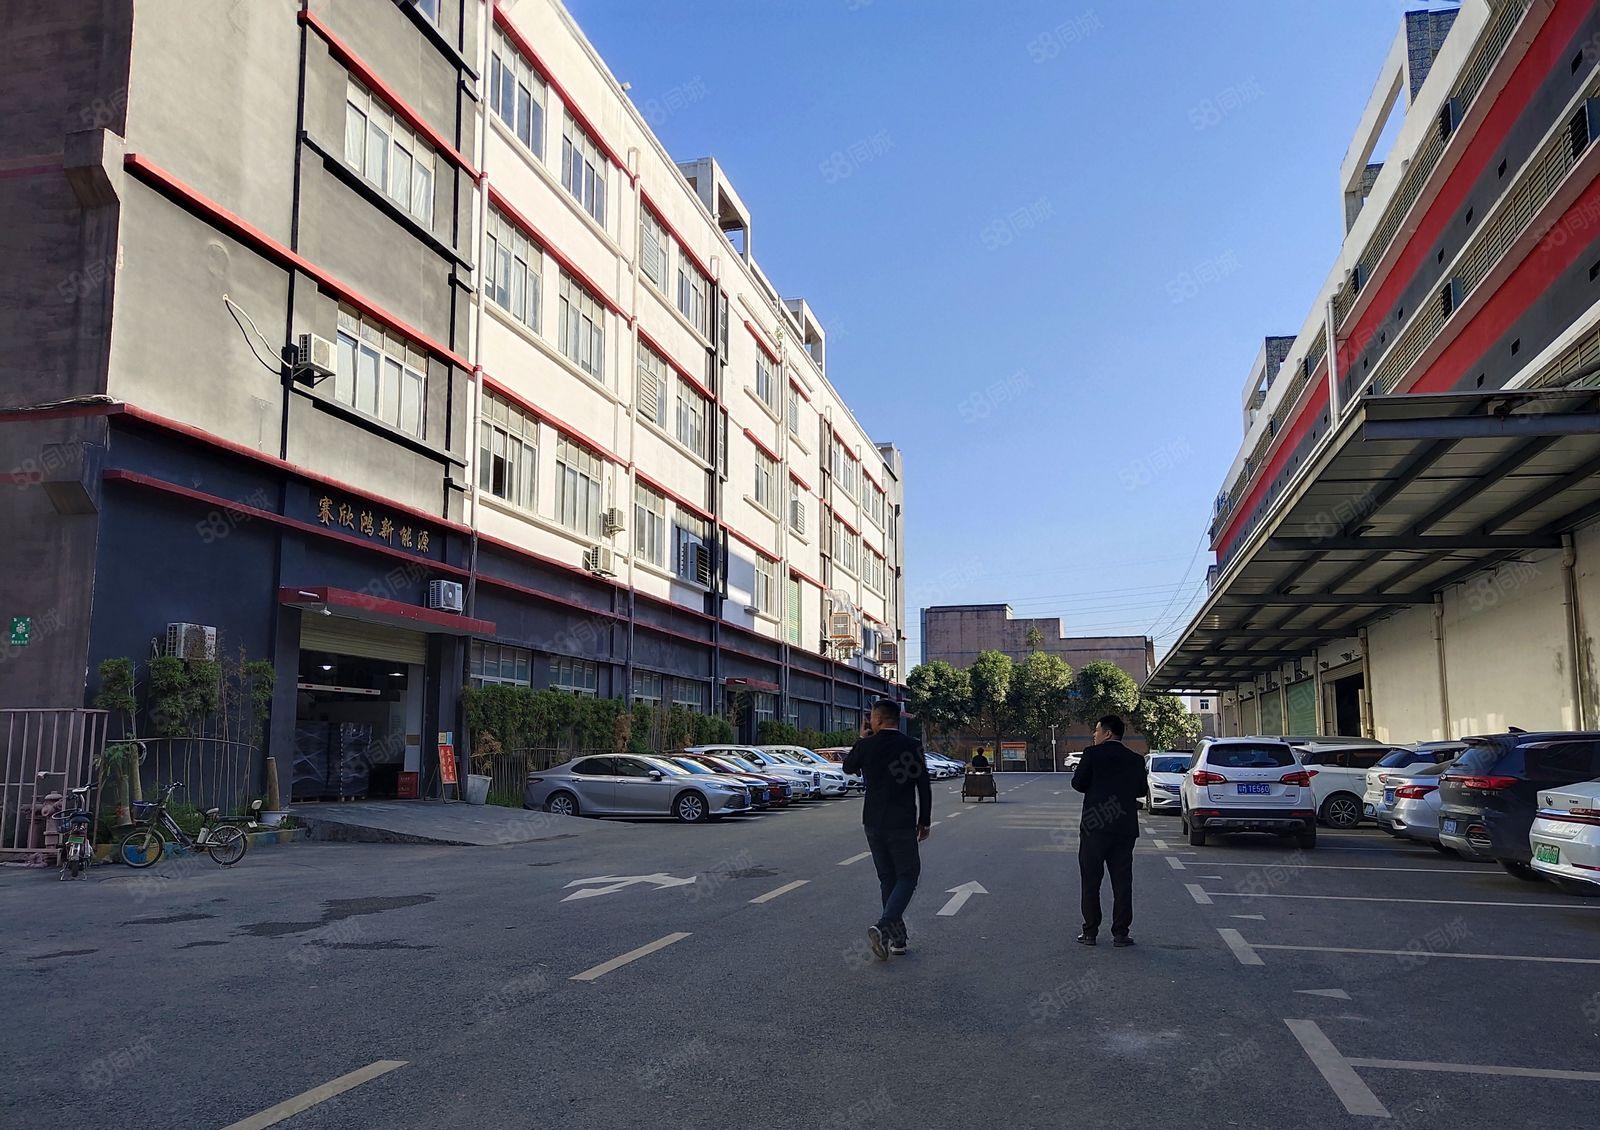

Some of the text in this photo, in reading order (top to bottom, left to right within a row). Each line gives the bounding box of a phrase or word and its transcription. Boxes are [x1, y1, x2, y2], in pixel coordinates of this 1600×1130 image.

[317, 496, 429, 552] 赛欣鸿新能源
